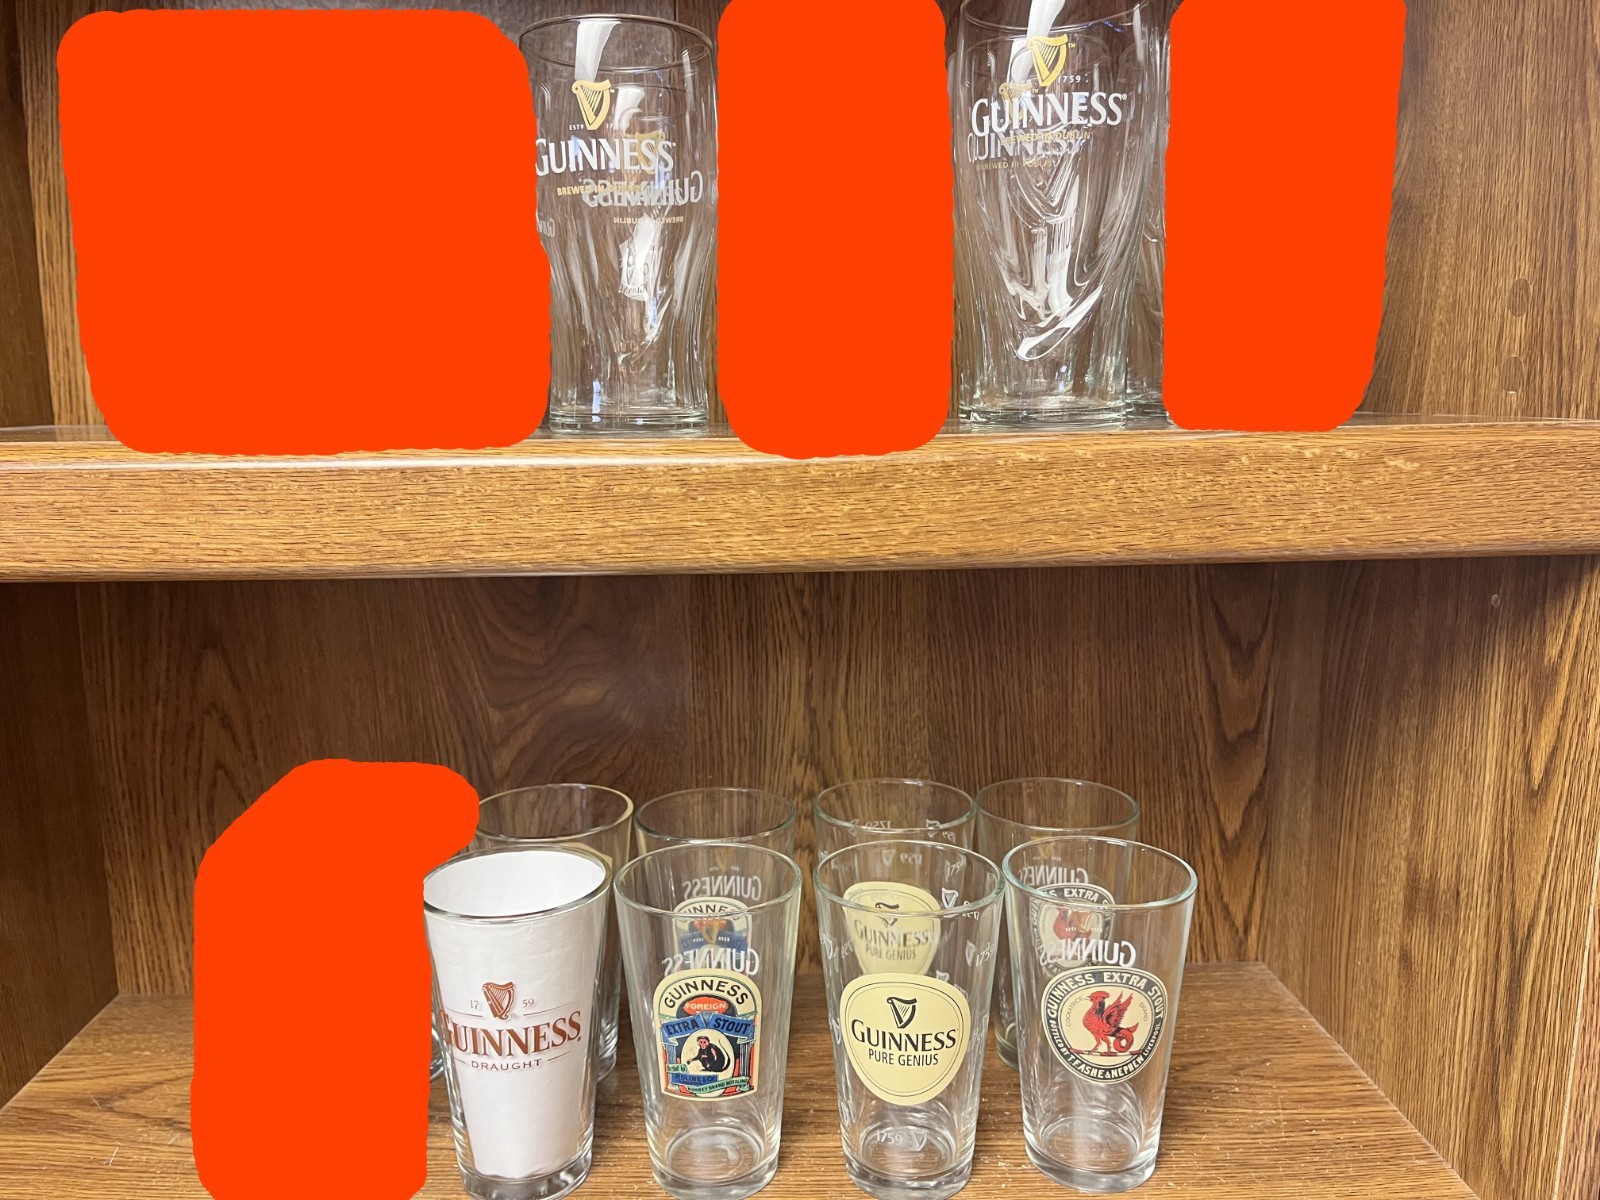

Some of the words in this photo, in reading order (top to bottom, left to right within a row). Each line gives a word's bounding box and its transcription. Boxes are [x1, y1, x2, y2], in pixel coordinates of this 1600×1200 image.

[971, 91, 1123, 137] GUINNESS
[535, 138, 675, 177] GUINNESS
[1063, 888, 1100, 903] EXTRA
[664, 979, 749, 1009] GUINNESS
[1047, 973, 1096, 1019] GUINNESS
[1103, 972, 1148, 990] EXTRA
[1147, 985, 1164, 1019] STOUT
[470, 1000, 479, 1010] 17
[522, 998, 535, 1008] 59
[685, 1002, 727, 1010] FOREIGN
[437, 1009, 582, 1057] GUINNESS
[665, 1019, 700, 1036] EXTRA
[713, 1017, 751, 1035] STOUT
[851, 1018, 957, 1052] GUINNESS
[471, 1059, 543, 1071] DRAUGHT
[868, 1048, 895, 1065] PURE
[897, 1053, 939, 1067] GENIUS
[876, 1130, 903, 1146] 1759
